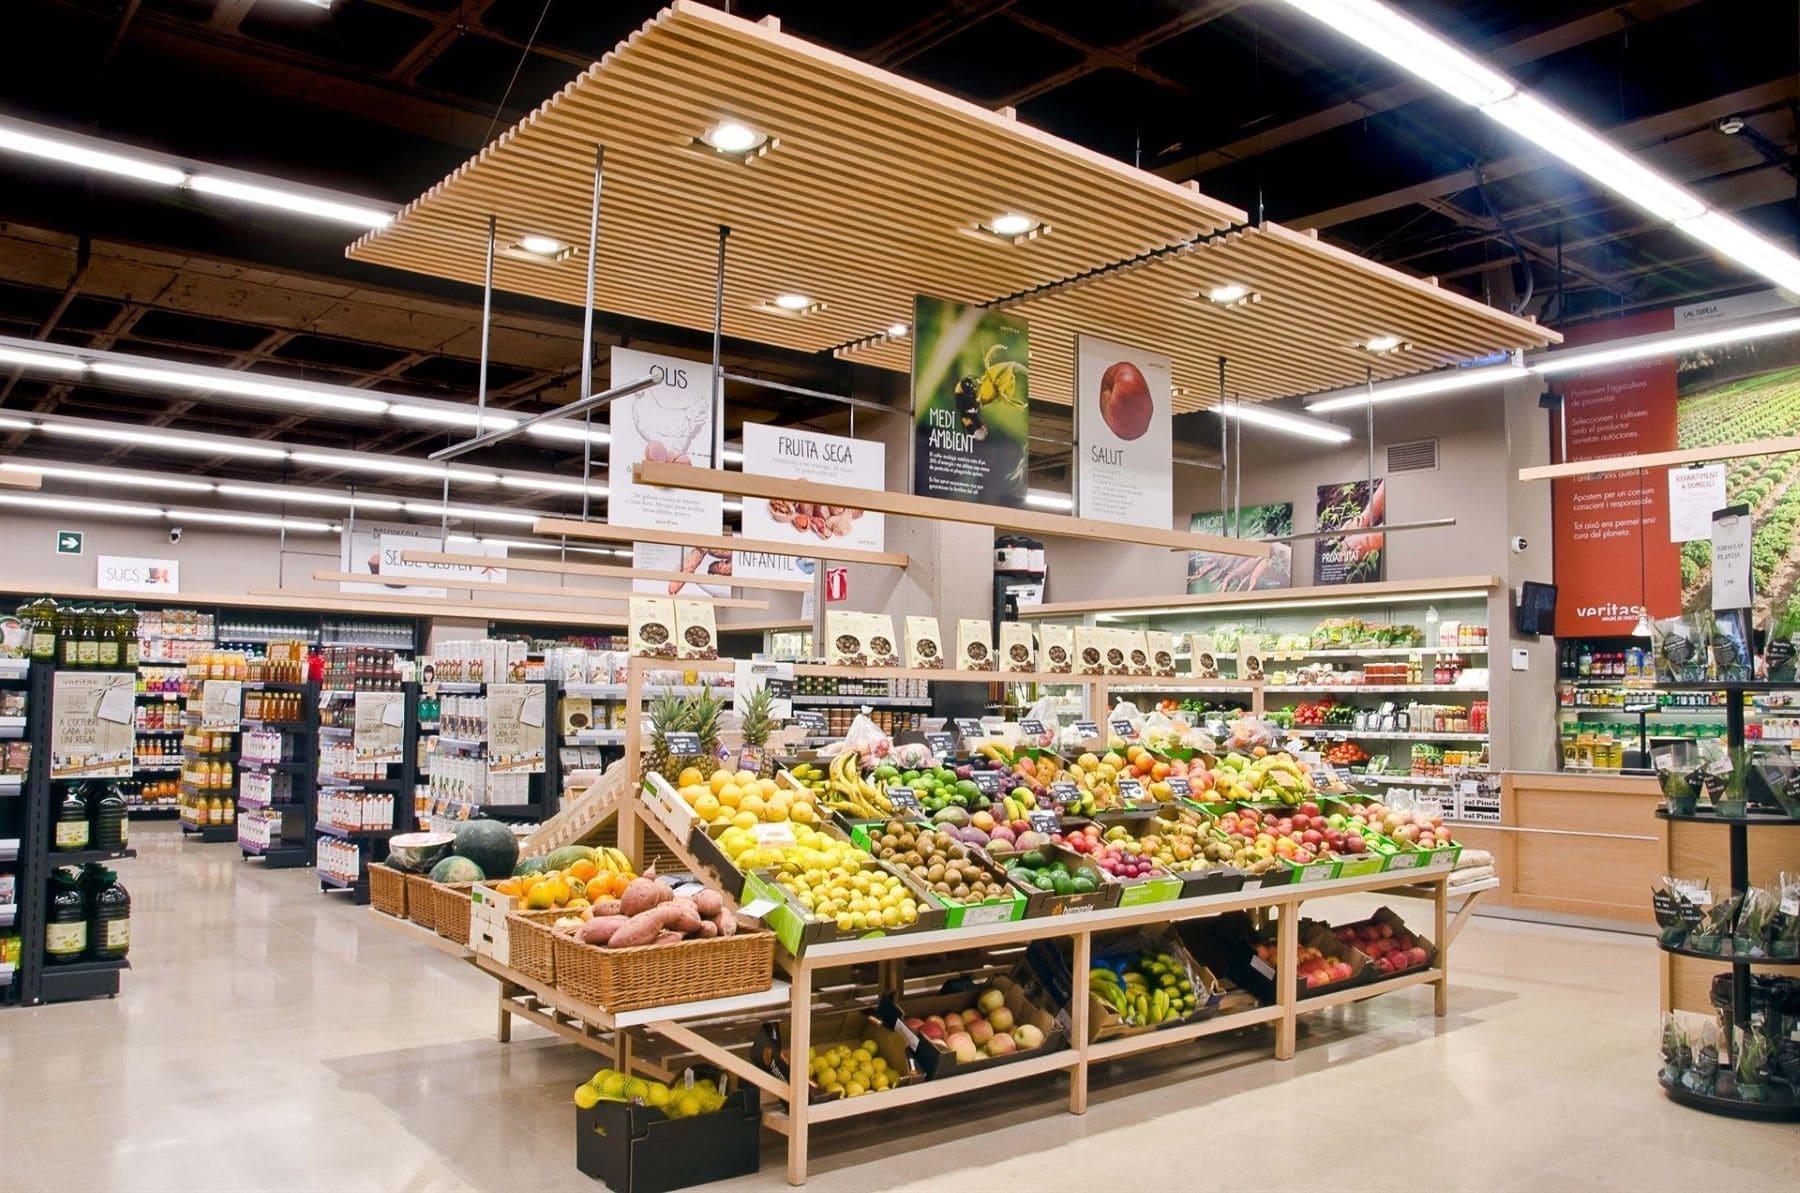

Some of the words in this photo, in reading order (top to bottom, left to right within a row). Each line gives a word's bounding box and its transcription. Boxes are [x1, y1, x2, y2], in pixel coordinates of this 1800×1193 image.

[650, 365, 688, 389] OUS
[930, 408, 956, 429] MEDI
[1620, 408, 1648, 420] cultivem
[1572, 426, 1588, 436] amb
[1596, 422, 1630, 433] productor
[929, 428, 975, 454] AMBIENT
[778, 436, 818, 460] FRUITA
[822, 443, 853, 464] SECA
[1091, 445, 1124, 466] SALUT
[1574, 494, 1602, 502] Apostem
[1604, 492, 1615, 500] per
[1574, 502, 1605, 512] conscient
[1574, 522, 1584, 530] Tot
[1615, 518, 1640, 528] permet
[1590, 530, 1601, 538] del
[738, 552, 794, 572] INFANTIL
[1322, 550, 1360, 564] PROXIMITAT
[106, 567, 140, 583] SUCS
[1577, 602, 1640, 617] veritas
[62, 727, 80, 735] CADA
[60, 736, 73, 744] UN
[75, 736, 97, 744] REGAL
